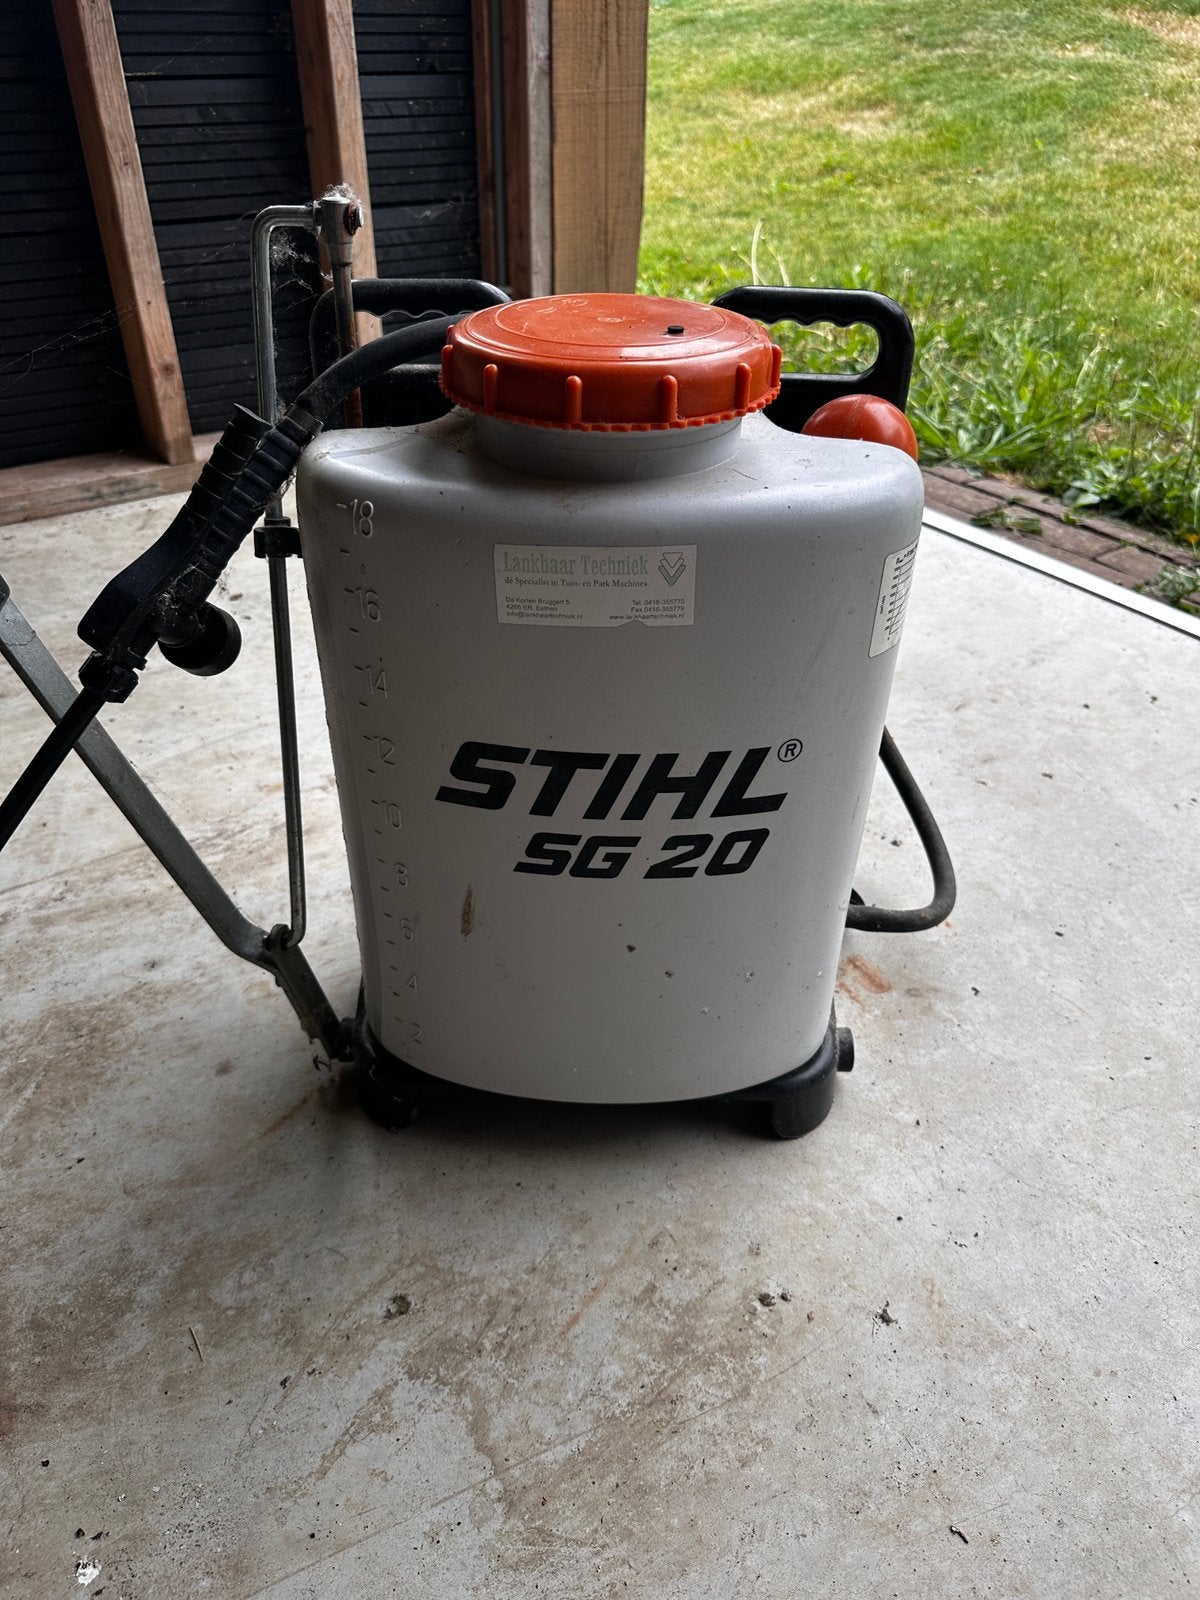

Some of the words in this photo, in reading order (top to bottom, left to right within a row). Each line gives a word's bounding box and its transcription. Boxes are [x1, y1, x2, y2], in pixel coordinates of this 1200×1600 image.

[351, 498, 374, 538] 18
[503, 552, 577, 575] Lankhaar
[580, 554, 649, 576] Techniek
[514, 576, 550, 587] Specialist
[551, 578, 559, 586] in
[593, 579, 610, 587] Park
[612, 579, 648, 588] Machines
[355, 587, 381, 623] 16
[364, 664, 389, 700] 14
[373, 735, 396, 767] 12
[434, 741, 788, 820] STIHL
[380, 800, 403, 830] 10
[513, 831, 643, 880] SG
[643, 828, 770, 880] 20
[395, 861, 409, 889] 8
[401, 912, 414, 942] 6
[406, 971, 419, 994] 4
[410, 1022, 424, 1046] 2
